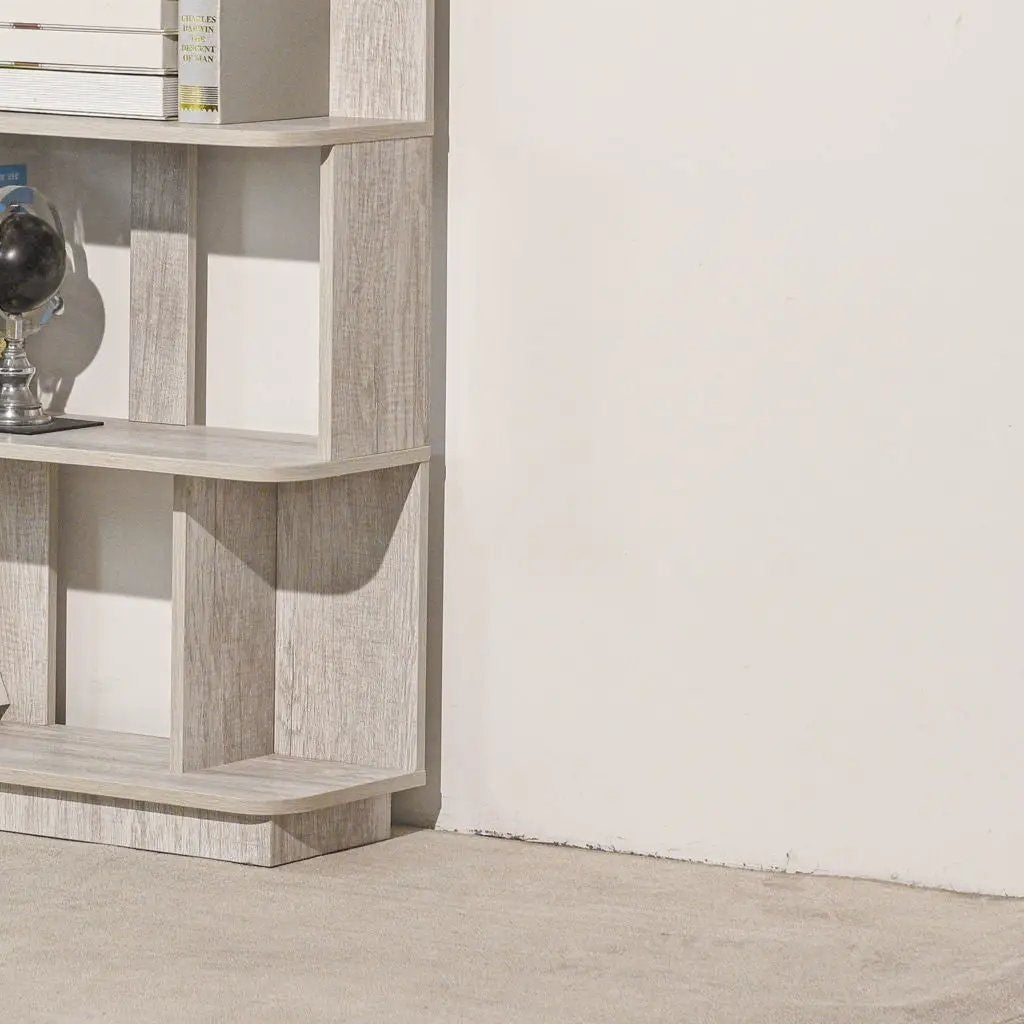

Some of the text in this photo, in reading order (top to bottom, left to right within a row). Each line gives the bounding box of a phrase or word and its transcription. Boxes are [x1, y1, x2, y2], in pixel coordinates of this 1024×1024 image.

[182, 16, 216, 24] CHARLES
[182, 44, 216, 53] DESCENT
[195, 55, 214, 63] MAN
